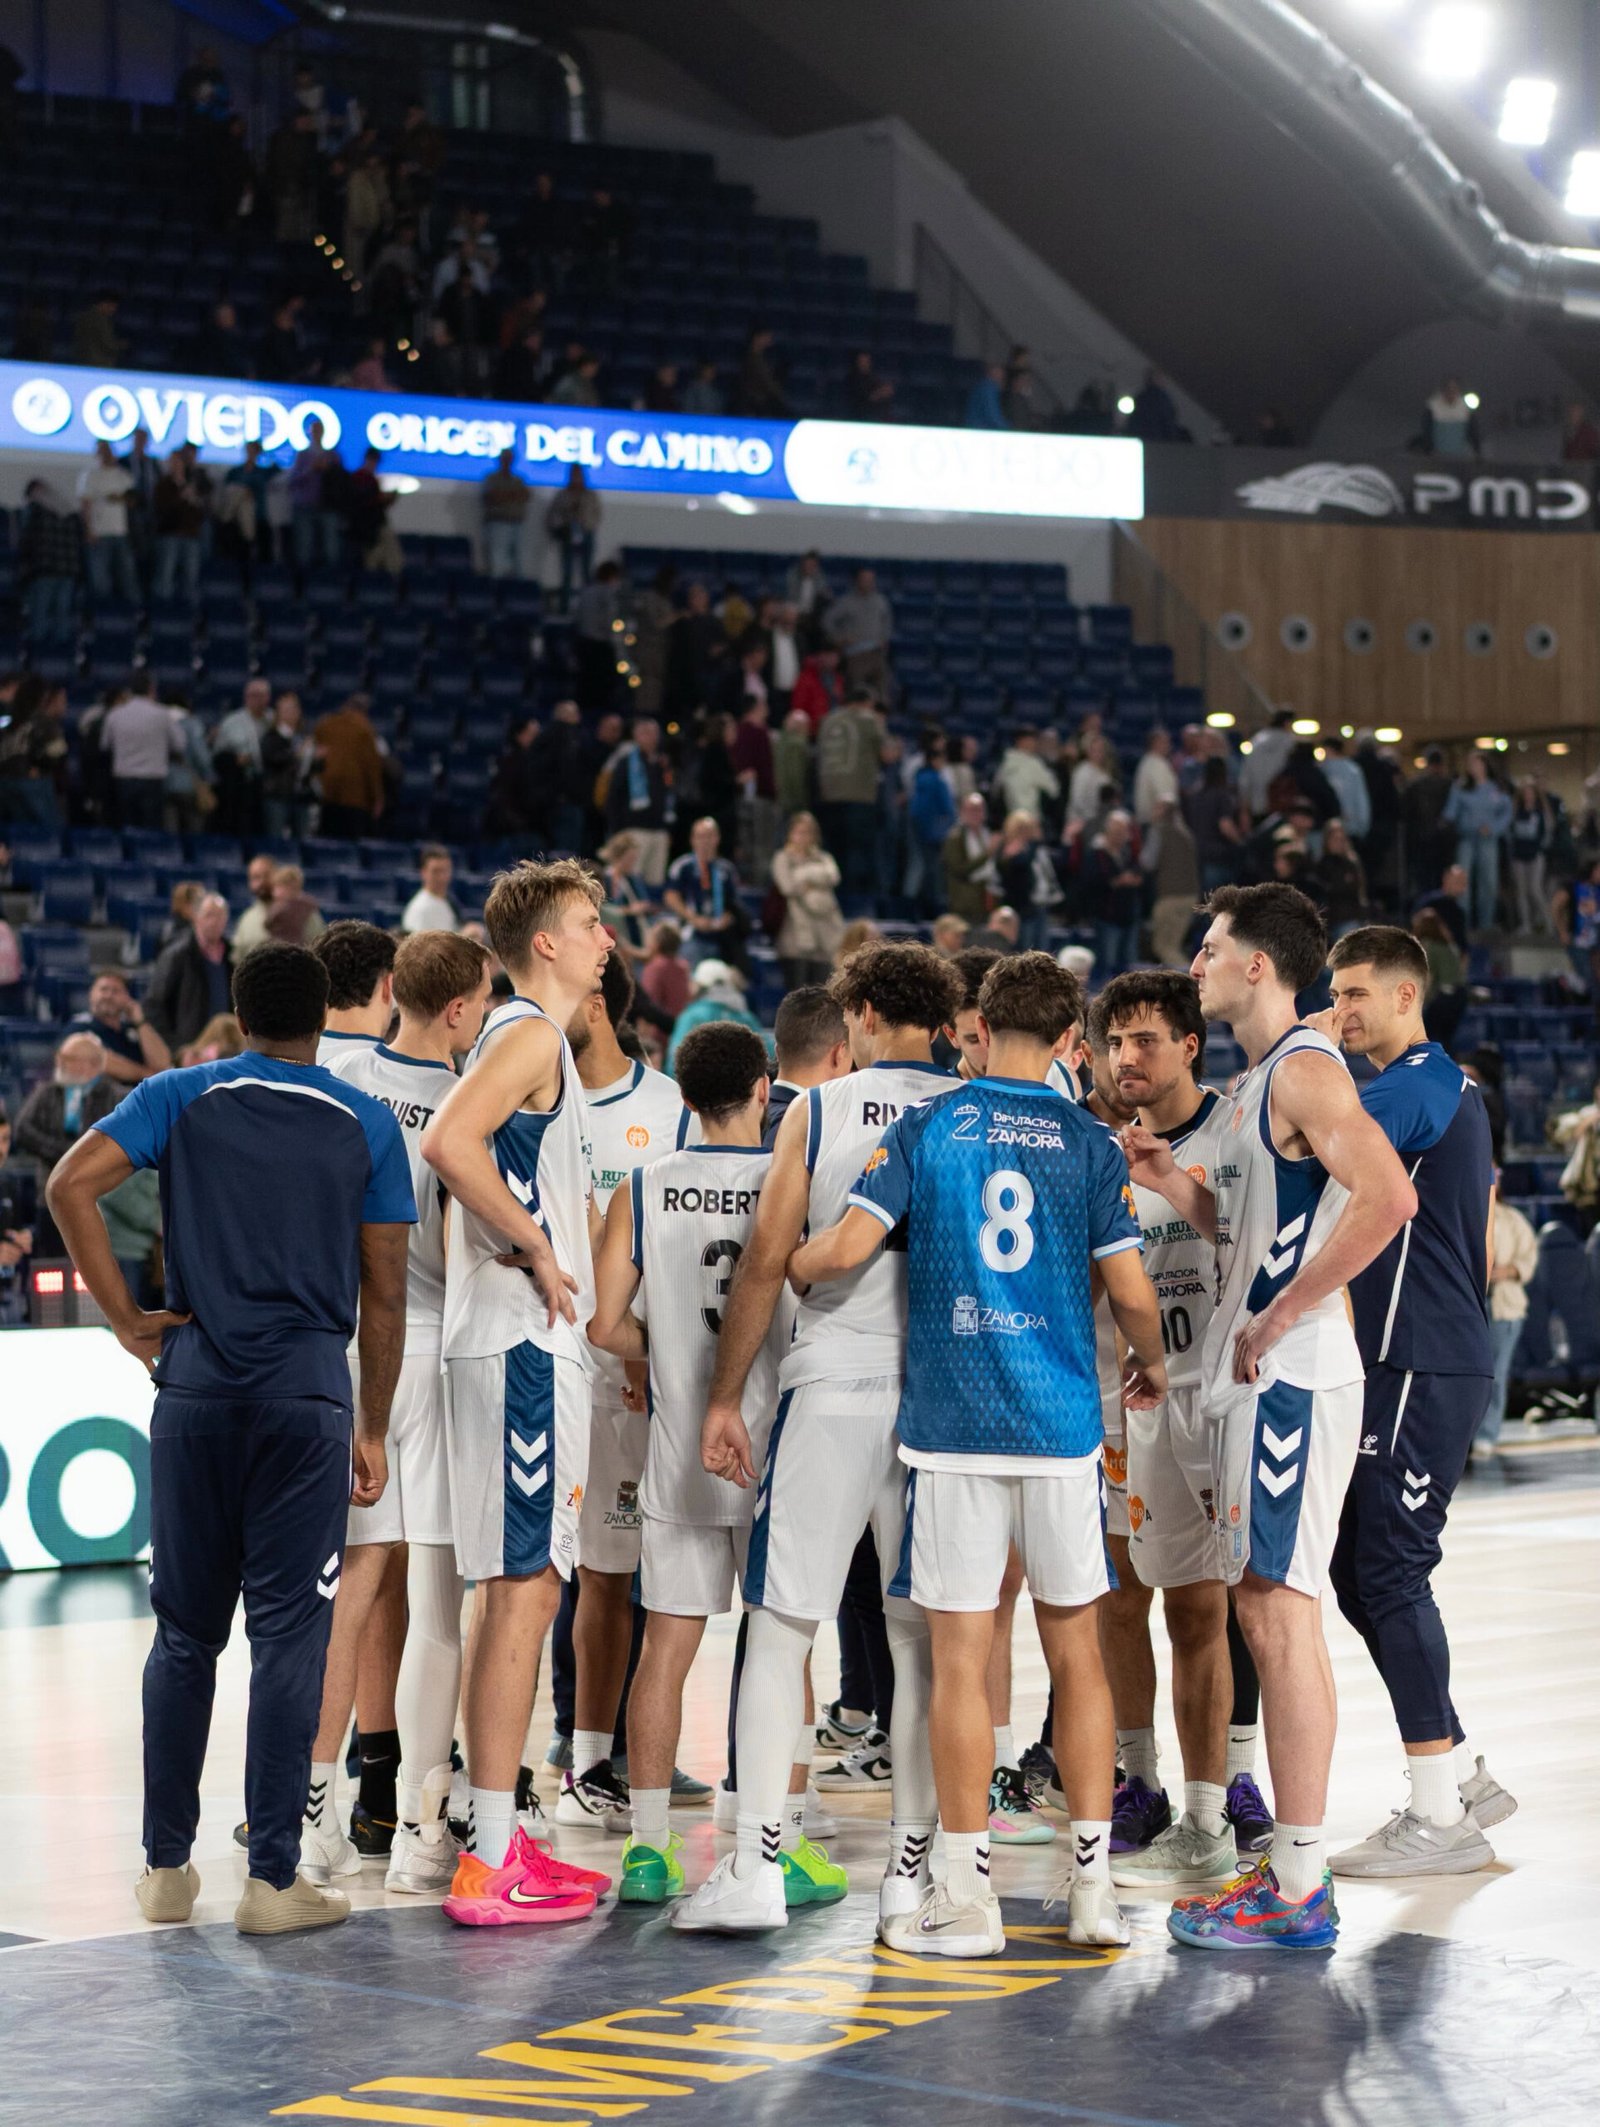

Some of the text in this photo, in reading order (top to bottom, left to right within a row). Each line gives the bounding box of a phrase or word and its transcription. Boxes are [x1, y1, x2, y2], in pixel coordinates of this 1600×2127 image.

[83, 385, 341, 452] OVIEDO
[366, 412, 773, 475] ORIGEN DEL CAMINO
[993, 1111, 1061, 1130] DIPUTACION
[986, 1128, 1065, 1150] ZAMORA
[979, 1170, 1035, 1273] 8
[1162, 1231, 1201, 1245] ZAMORA
[1157, 1282, 1207, 1298] AMORA
[981, 1308, 1048, 1331] ZAMORA
[603, 1512, 643, 1526] ZAMOR
